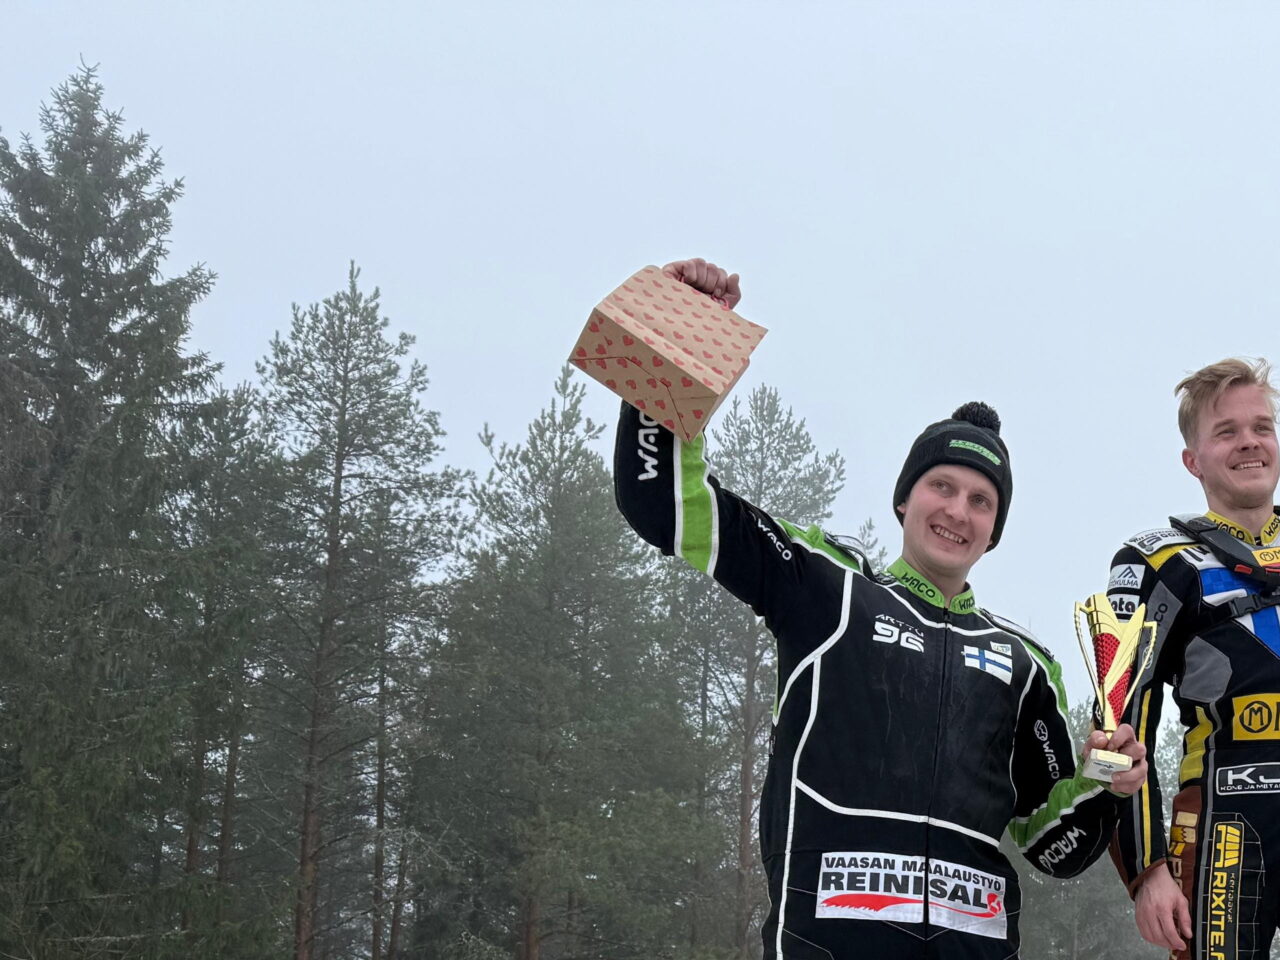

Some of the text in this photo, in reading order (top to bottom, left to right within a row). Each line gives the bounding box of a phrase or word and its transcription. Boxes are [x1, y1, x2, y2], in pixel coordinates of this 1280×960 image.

[757, 518, 793, 561] WACO
[901, 572, 936, 599] WACO
[872, 620, 925, 653] 96
[1042, 741, 1061, 780] WACO
[1046, 826, 1087, 863] WACO
[824, 856, 1002, 892] VAASAN MAALAUSTYÖ
